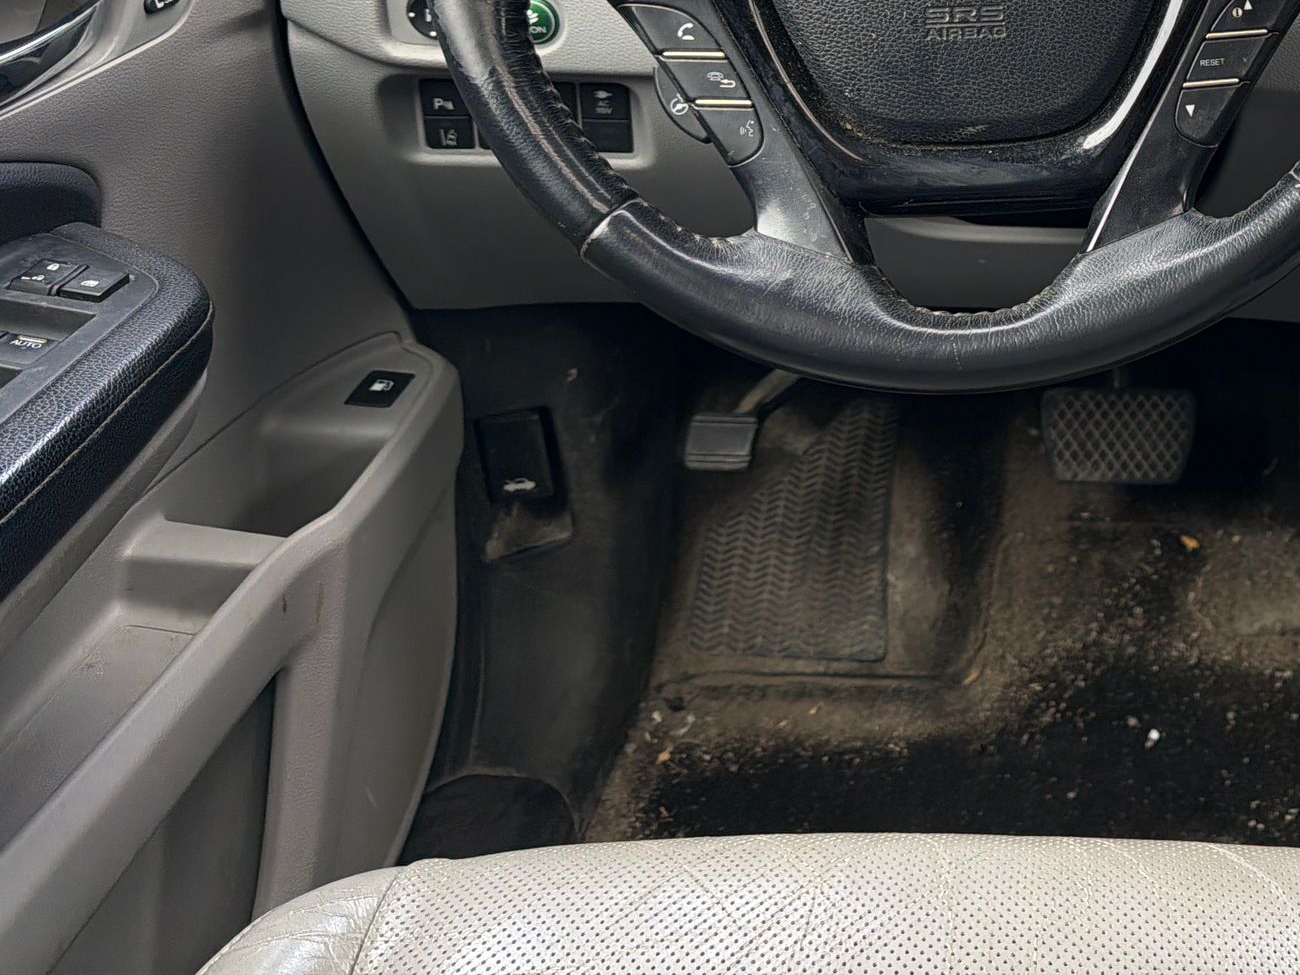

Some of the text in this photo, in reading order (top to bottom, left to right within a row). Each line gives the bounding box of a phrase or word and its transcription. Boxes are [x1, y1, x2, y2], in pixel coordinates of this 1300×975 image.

[926, 6, 1005, 23] SRS
[925, 27, 1007, 41] AIRBAG
[1200, 58, 1225, 67] RESET
[10, 339, 42, 349] AUTO
